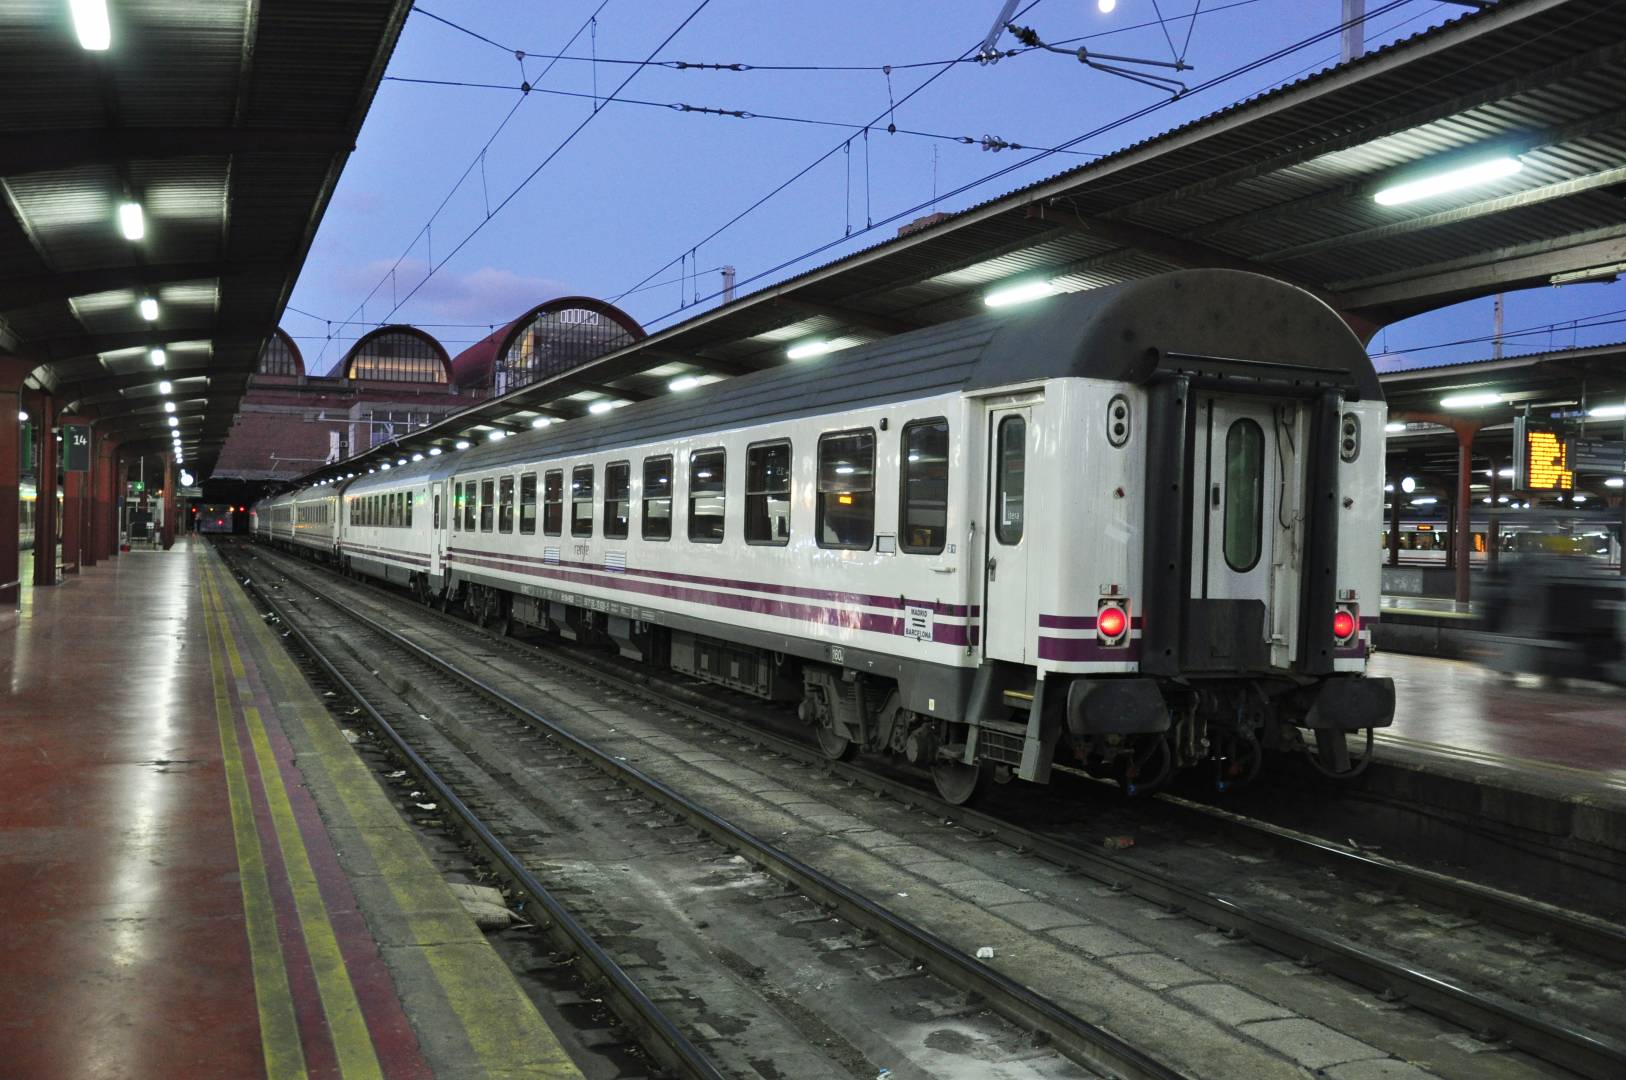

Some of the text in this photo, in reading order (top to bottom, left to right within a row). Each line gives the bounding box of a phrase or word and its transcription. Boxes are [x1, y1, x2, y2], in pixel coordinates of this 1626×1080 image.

[73, 434, 88, 446] 14
[910, 608, 928, 618] MADRID
[905, 627, 931, 639] BARCELONA
